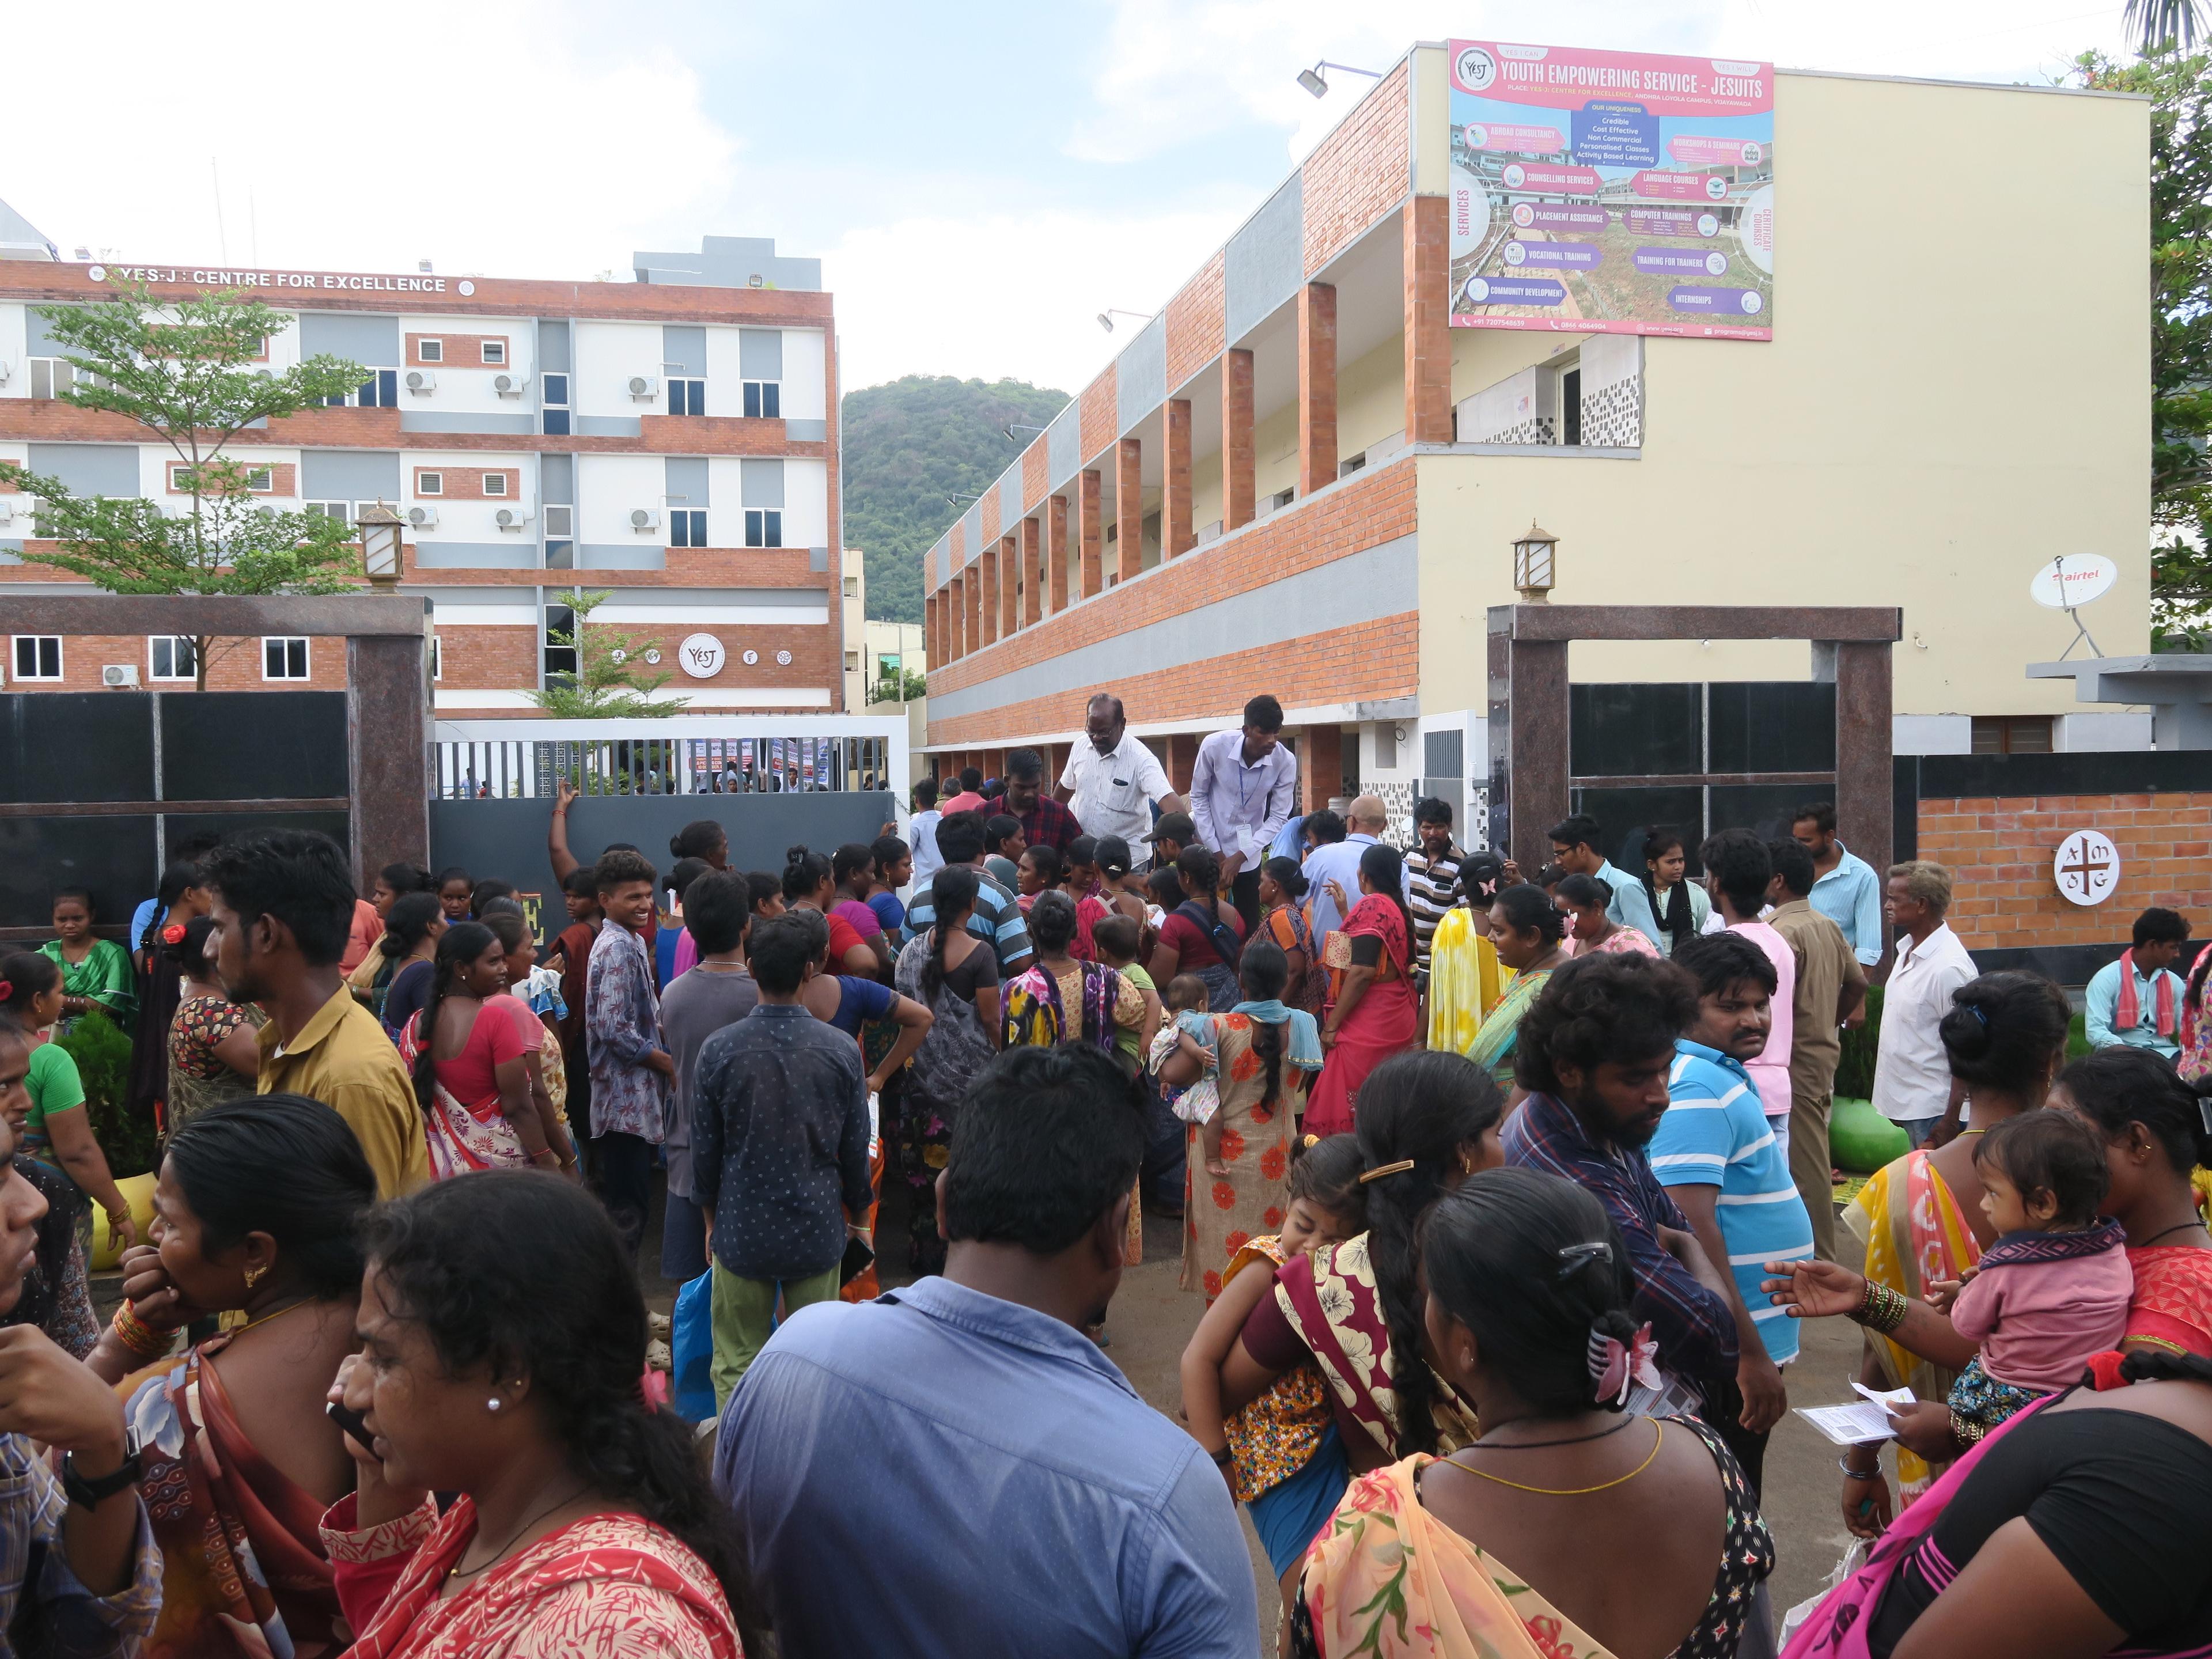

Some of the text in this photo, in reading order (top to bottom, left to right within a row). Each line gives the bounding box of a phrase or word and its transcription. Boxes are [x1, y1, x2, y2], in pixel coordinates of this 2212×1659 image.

[1500, 61, 1544, 83] YOUTH
[1548, 64, 1640, 89] EMPOWERING
[1644, 70, 1698, 93] SERVICE
[1711, 76, 1763, 99] JESUITS
[1593, 90, 1634, 99] EXCELLENCE,
[1686, 97, 1713, 105] CAMPUS,
[1714, 99, 1752, 107] VIJAYAWADA
[1606, 105, 1642, 113] UNIQUENESS
[1602, 118, 1629, 126] Credible
[1490, 127, 1555, 139] ABROAD CONSULTANCY
[1609, 127, 1639, 135] Effective
[1603, 135, 1642, 144] Commercial
[1673, 138, 1741, 151] WORKSHOPS & SEMINARS
[1580, 143, 1650, 153] Personalised Classes
[1577, 151, 1601, 160] Activity
[1625, 154, 1654, 164] Learning
[1527, 173, 1594, 185] COUNSELLING SERVICES
[1643, 173, 1699, 185] LANGUAGE COURSES
[1457, 190, 1469, 236] SERVICES
[1536, 211, 1604, 224] PLACEMENT ASSISTANCE
[1630, 210, 1692, 222] COMPUTER TRAININGS
[1753, 213, 1762, 246] COURSES
[1763, 209, 1772, 252] CERTIFICATE
[1528, 250, 1591, 262] VOCATIONAL TRAINING
[1637, 256, 1703, 268] TRAINING FOR TRAINERS
[120, 267, 176, 283] YES-J
[193, 270, 271, 286] CENTRE
[276, 274, 316, 288] FOR
[323, 275, 446, 292] EXCELLENCE
[1490, 287, 1562, 298] COMMUNITY DEVELOPMENT
[1675, 295, 1712, 305] INTERNSHIPS
[1714, 328, 1763, 338] programs@yesj.in
[2065, 569, 2099, 581] airtel
